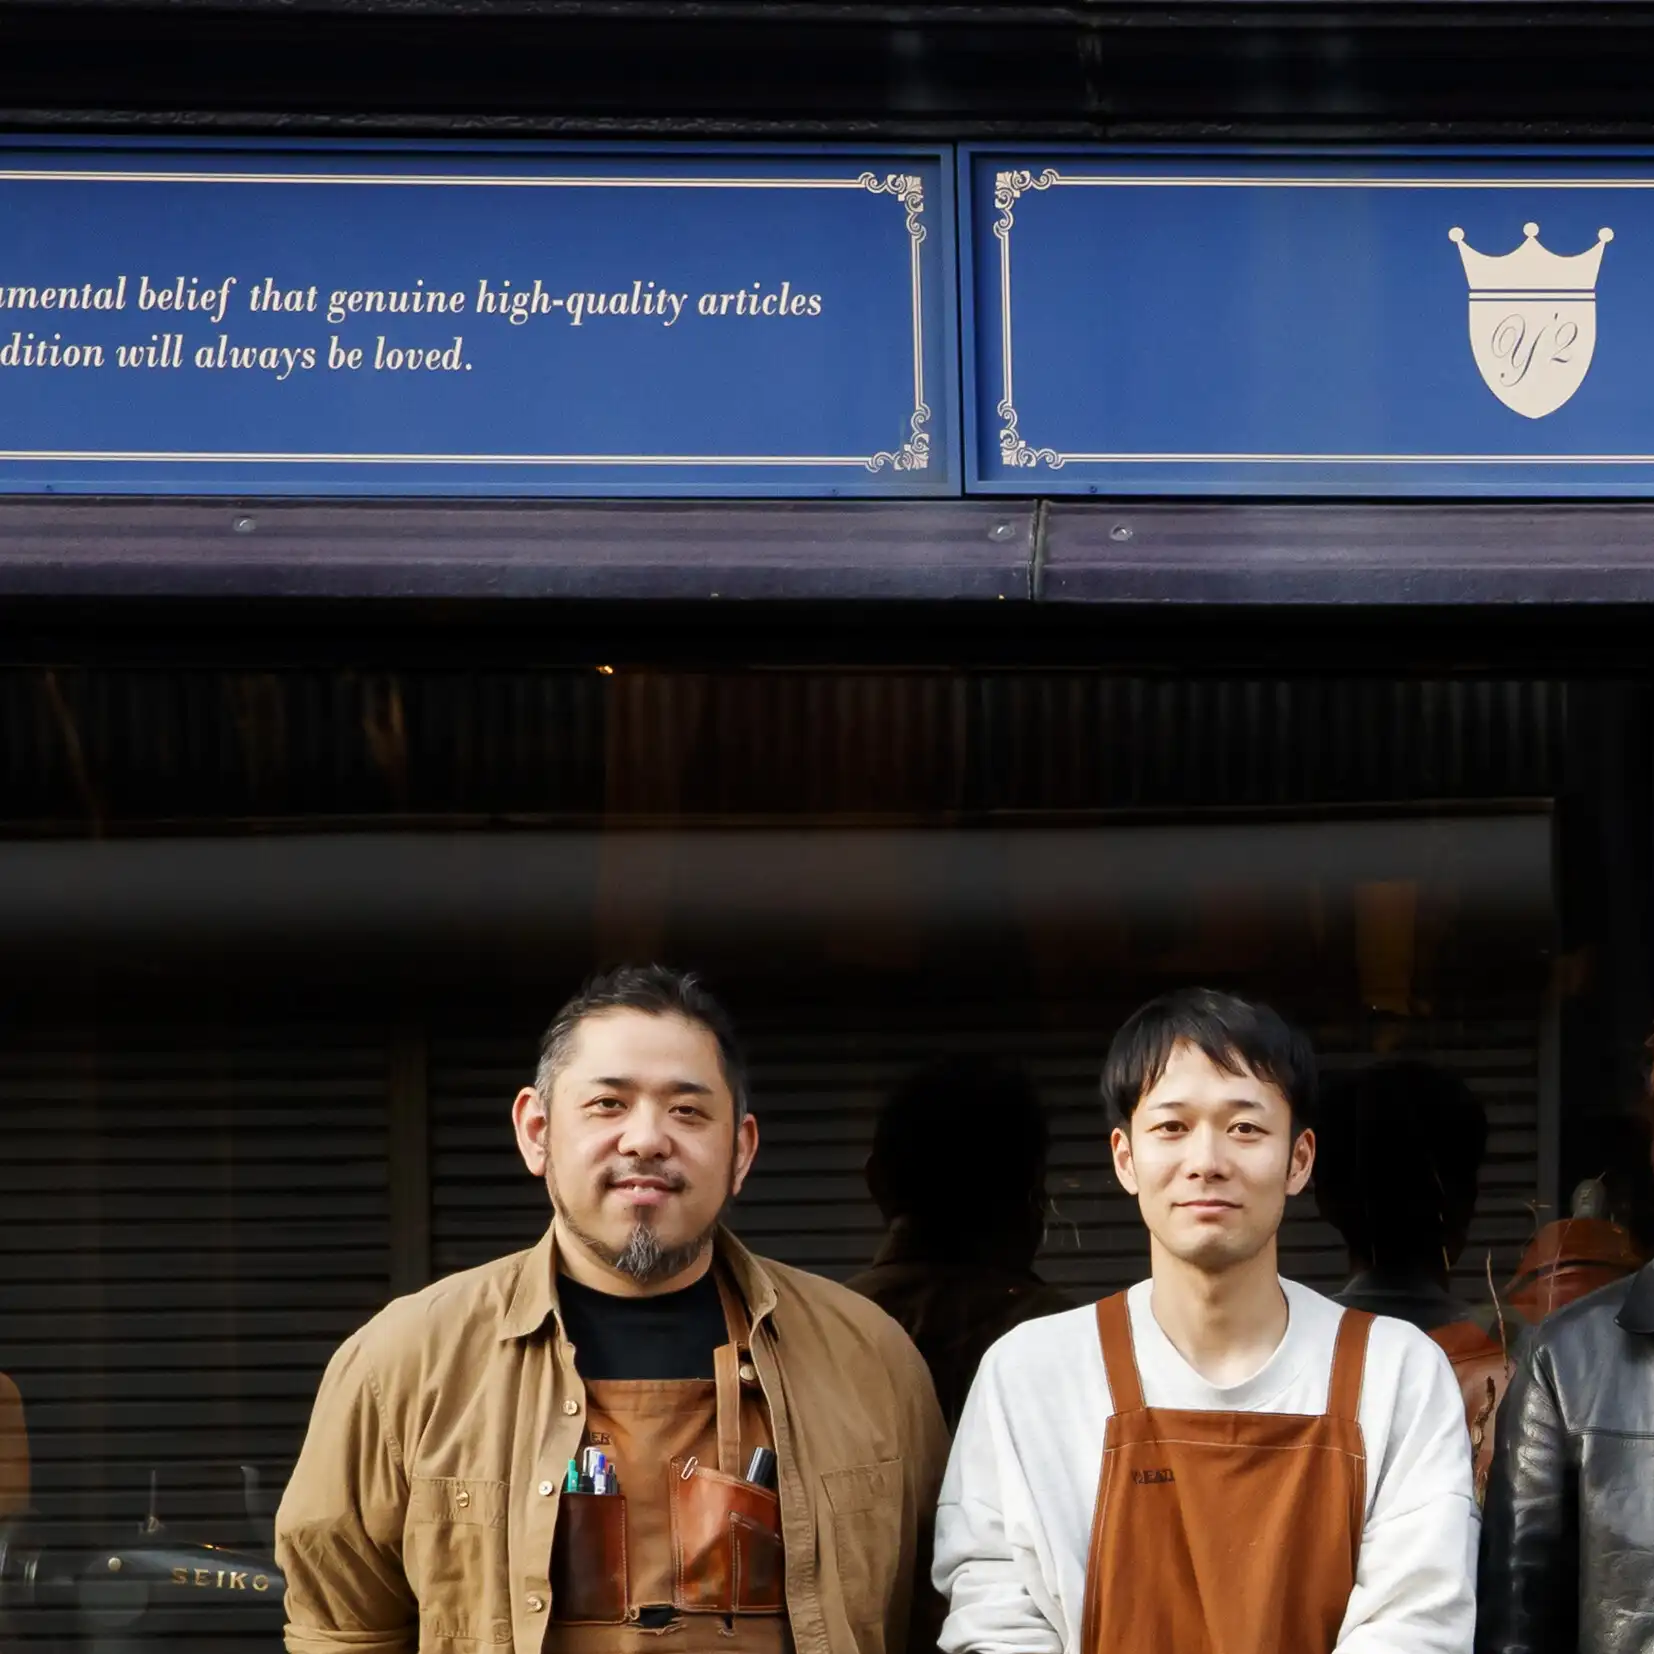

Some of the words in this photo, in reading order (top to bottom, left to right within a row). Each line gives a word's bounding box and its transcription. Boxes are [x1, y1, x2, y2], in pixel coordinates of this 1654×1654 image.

[138, 276, 237, 322] belief
[250, 278, 317, 312] that
[326, 280, 465, 323] genuine
[475, 280, 688, 326] high-quality
[698, 282, 822, 316] articles
[116, 334, 184, 367] will
[195, 335, 316, 380] always
[328, 336, 363, 369] be
[374, 336, 473, 371] loved.
[171, 1567, 270, 1592] SEIKO
